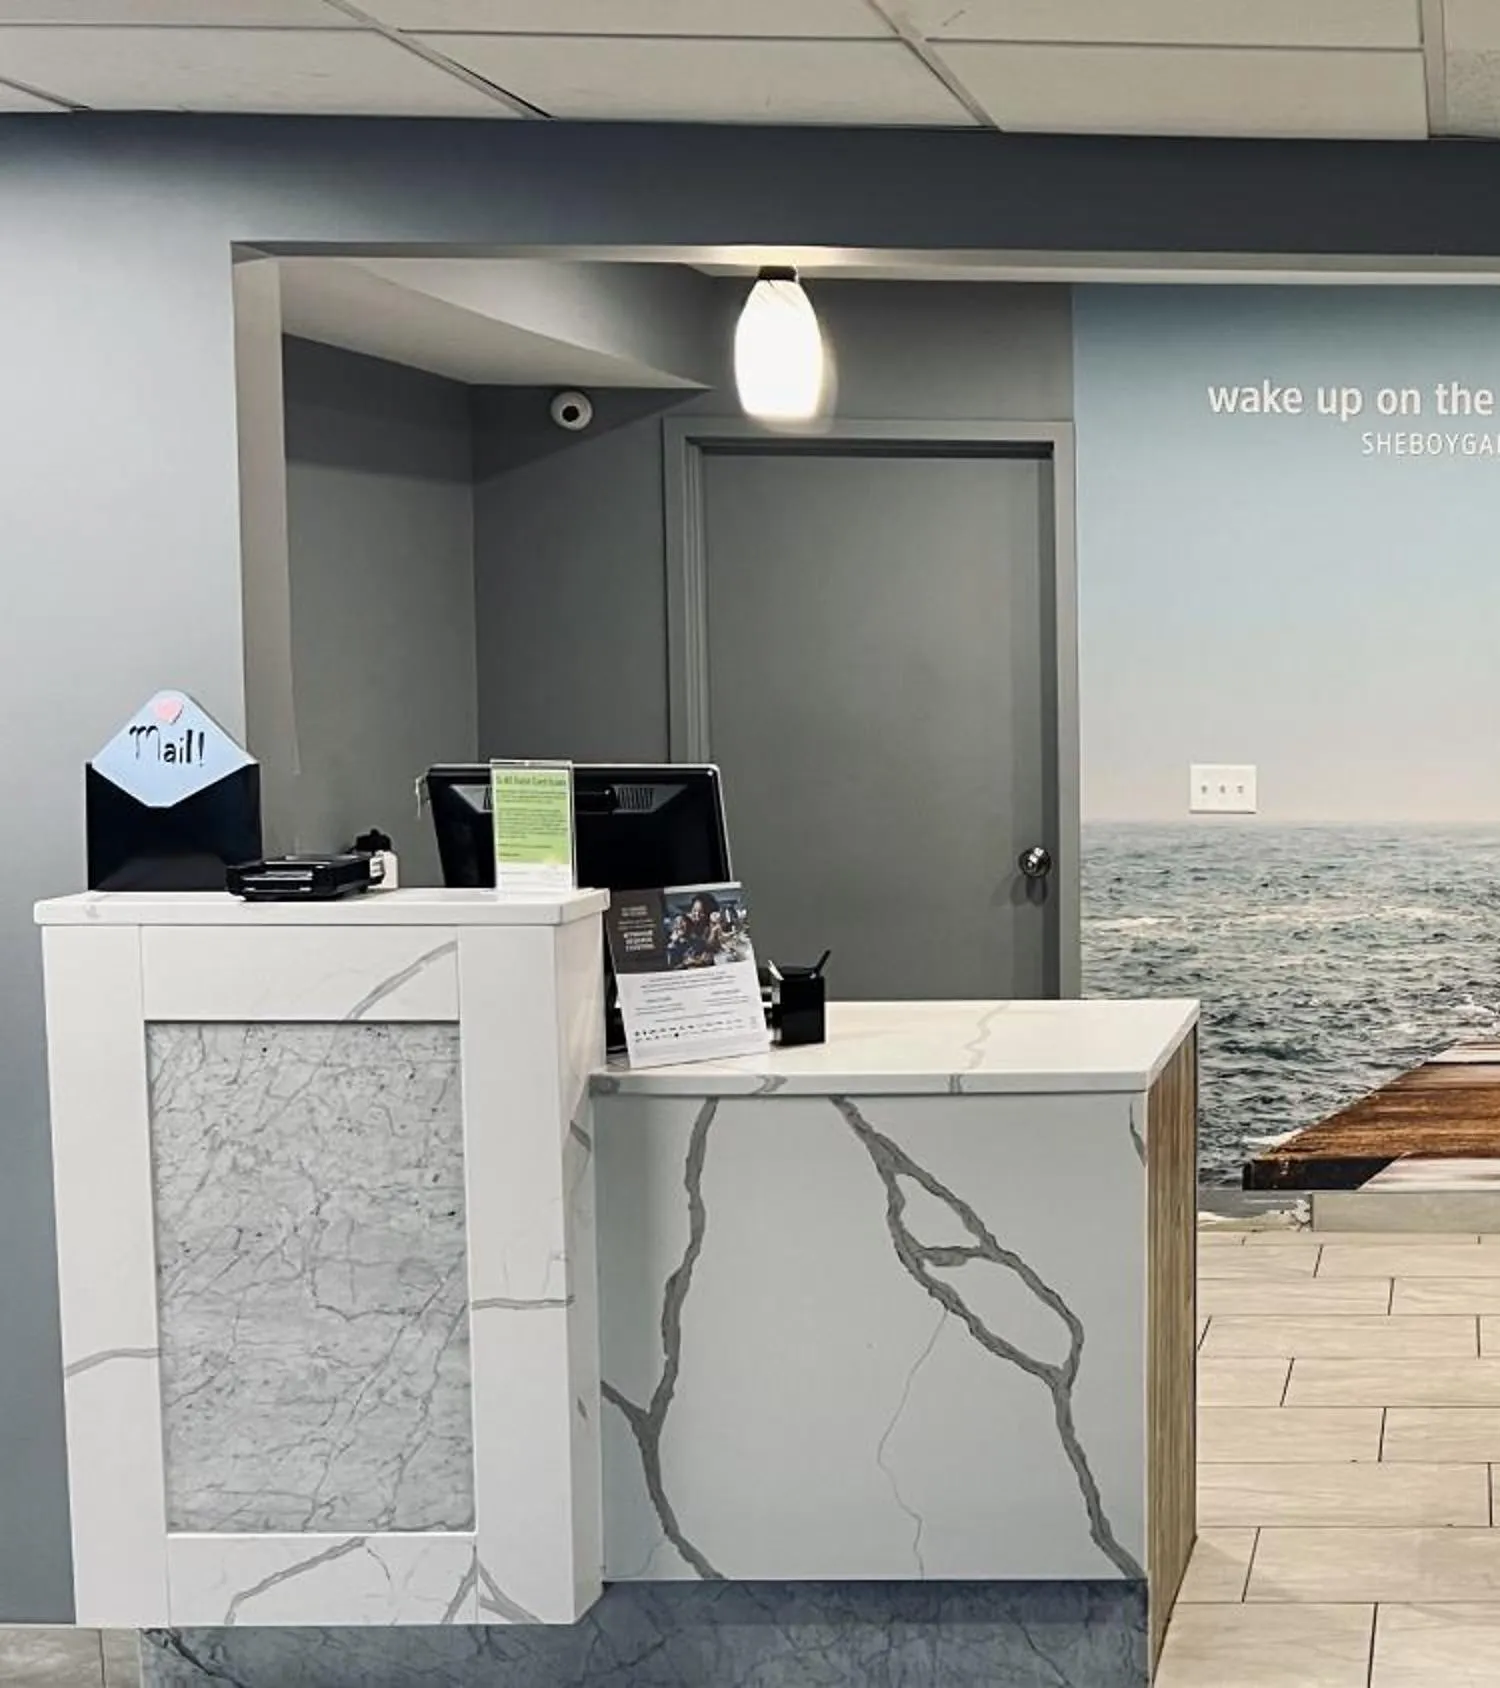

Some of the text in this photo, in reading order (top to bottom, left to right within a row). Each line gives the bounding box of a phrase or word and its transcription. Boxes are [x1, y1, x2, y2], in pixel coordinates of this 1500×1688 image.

[1207, 380, 1303, 414] wake
[1317, 387, 1362, 421] up
[1376, 388, 1421, 415] on
[1435, 383, 1494, 416] the
[129, 724, 205, 767] Mail!
